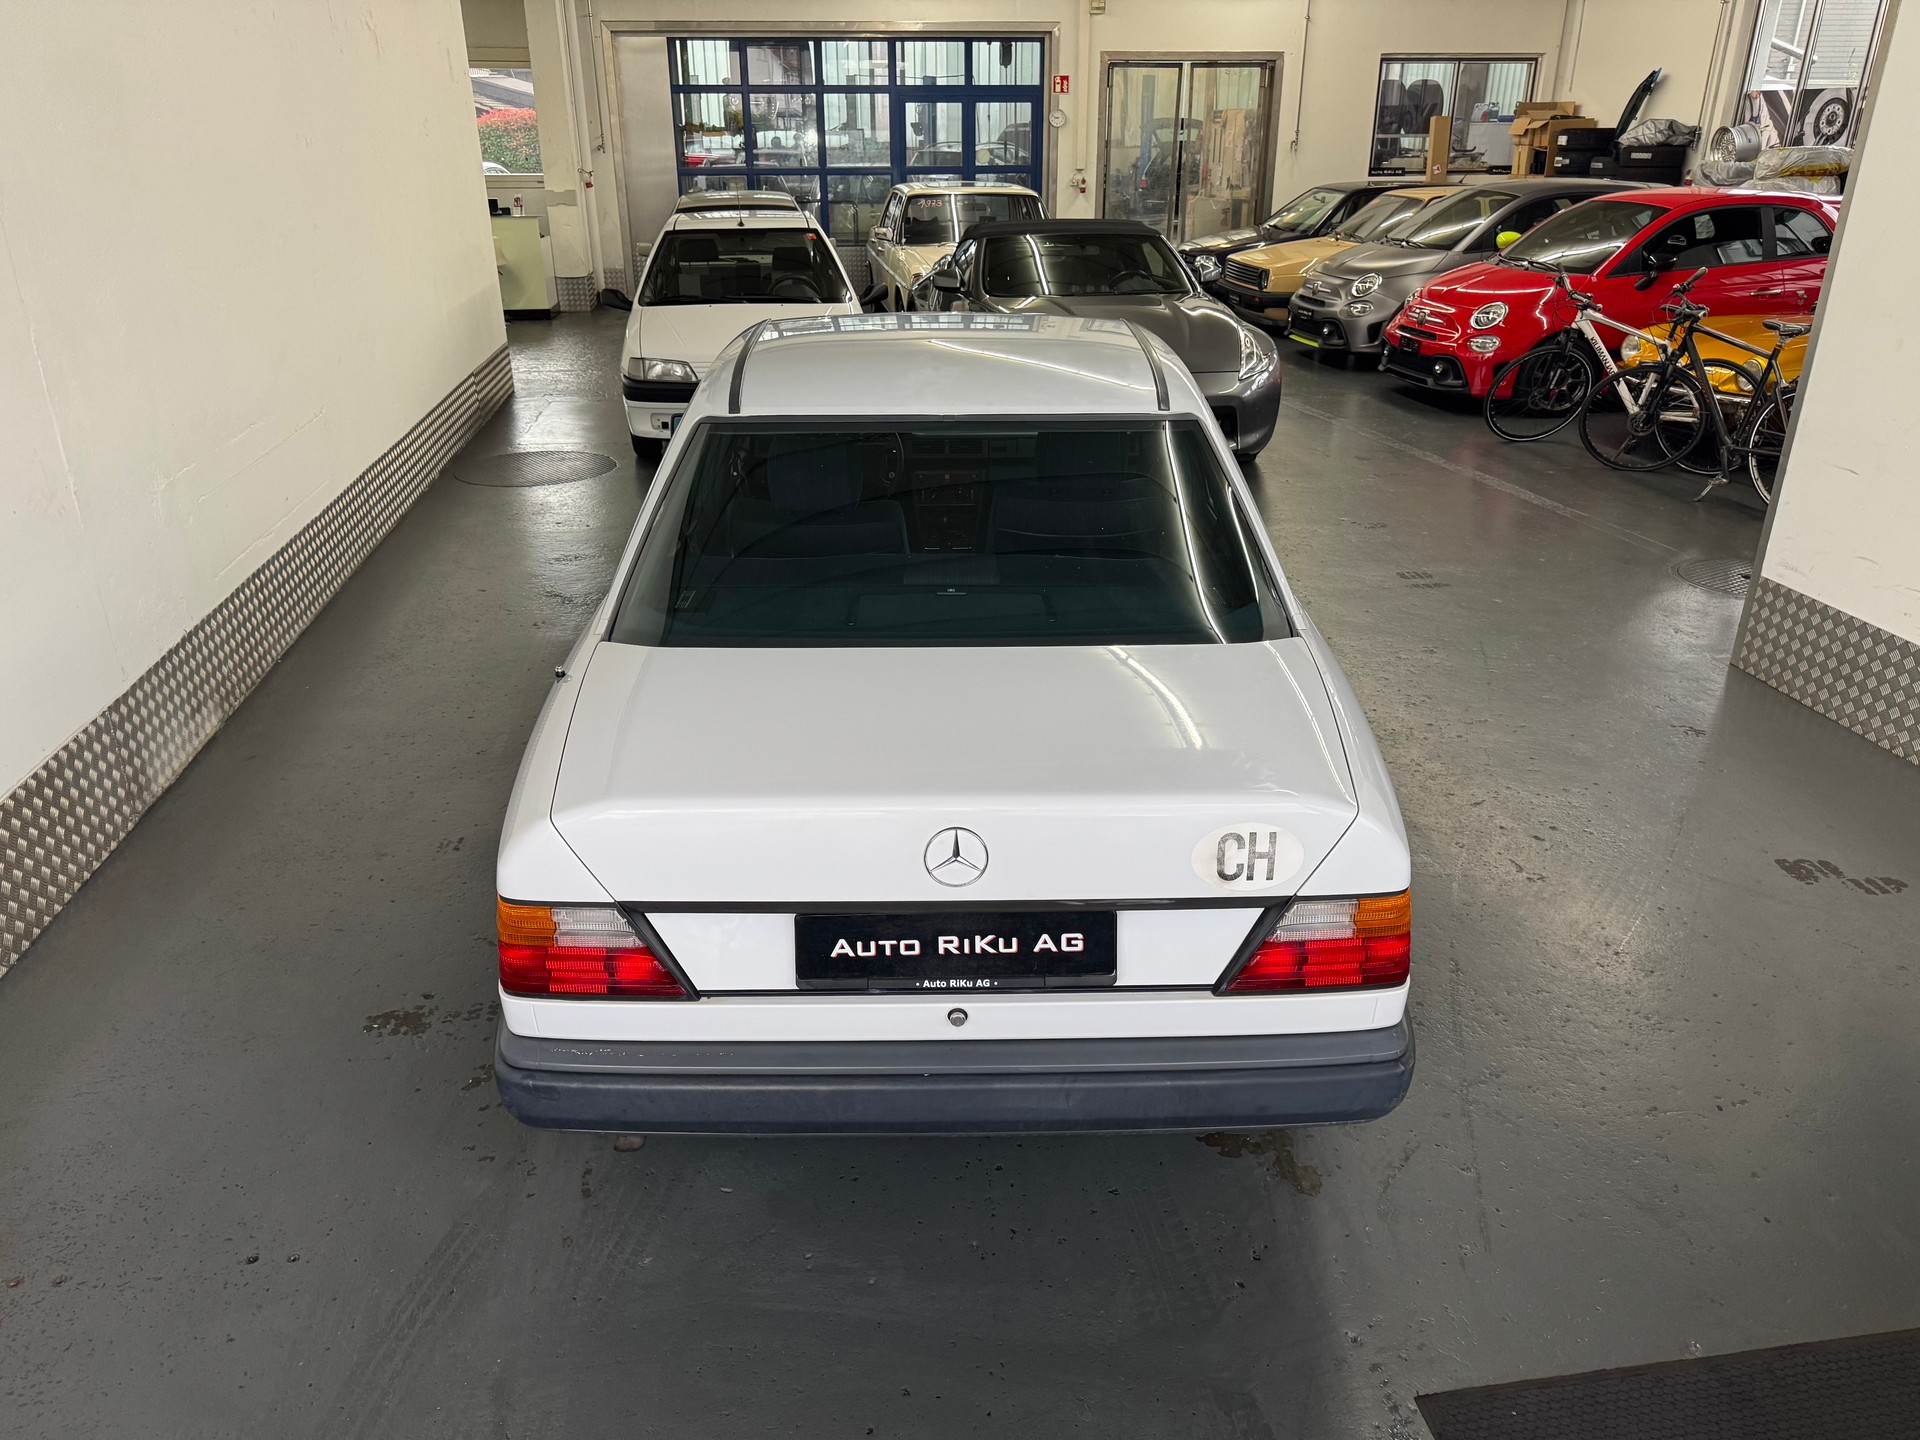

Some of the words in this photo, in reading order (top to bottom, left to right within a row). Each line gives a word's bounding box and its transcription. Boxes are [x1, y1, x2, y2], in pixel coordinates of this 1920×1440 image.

[1216, 831, 1278, 882] CH
[830, 938, 921, 958] AUTO
[1032, 932, 1084, 953] AG
[922, 979, 947, 988] Auto
[949, 978, 973, 988] RiKu
[975, 978, 991, 988] AG
